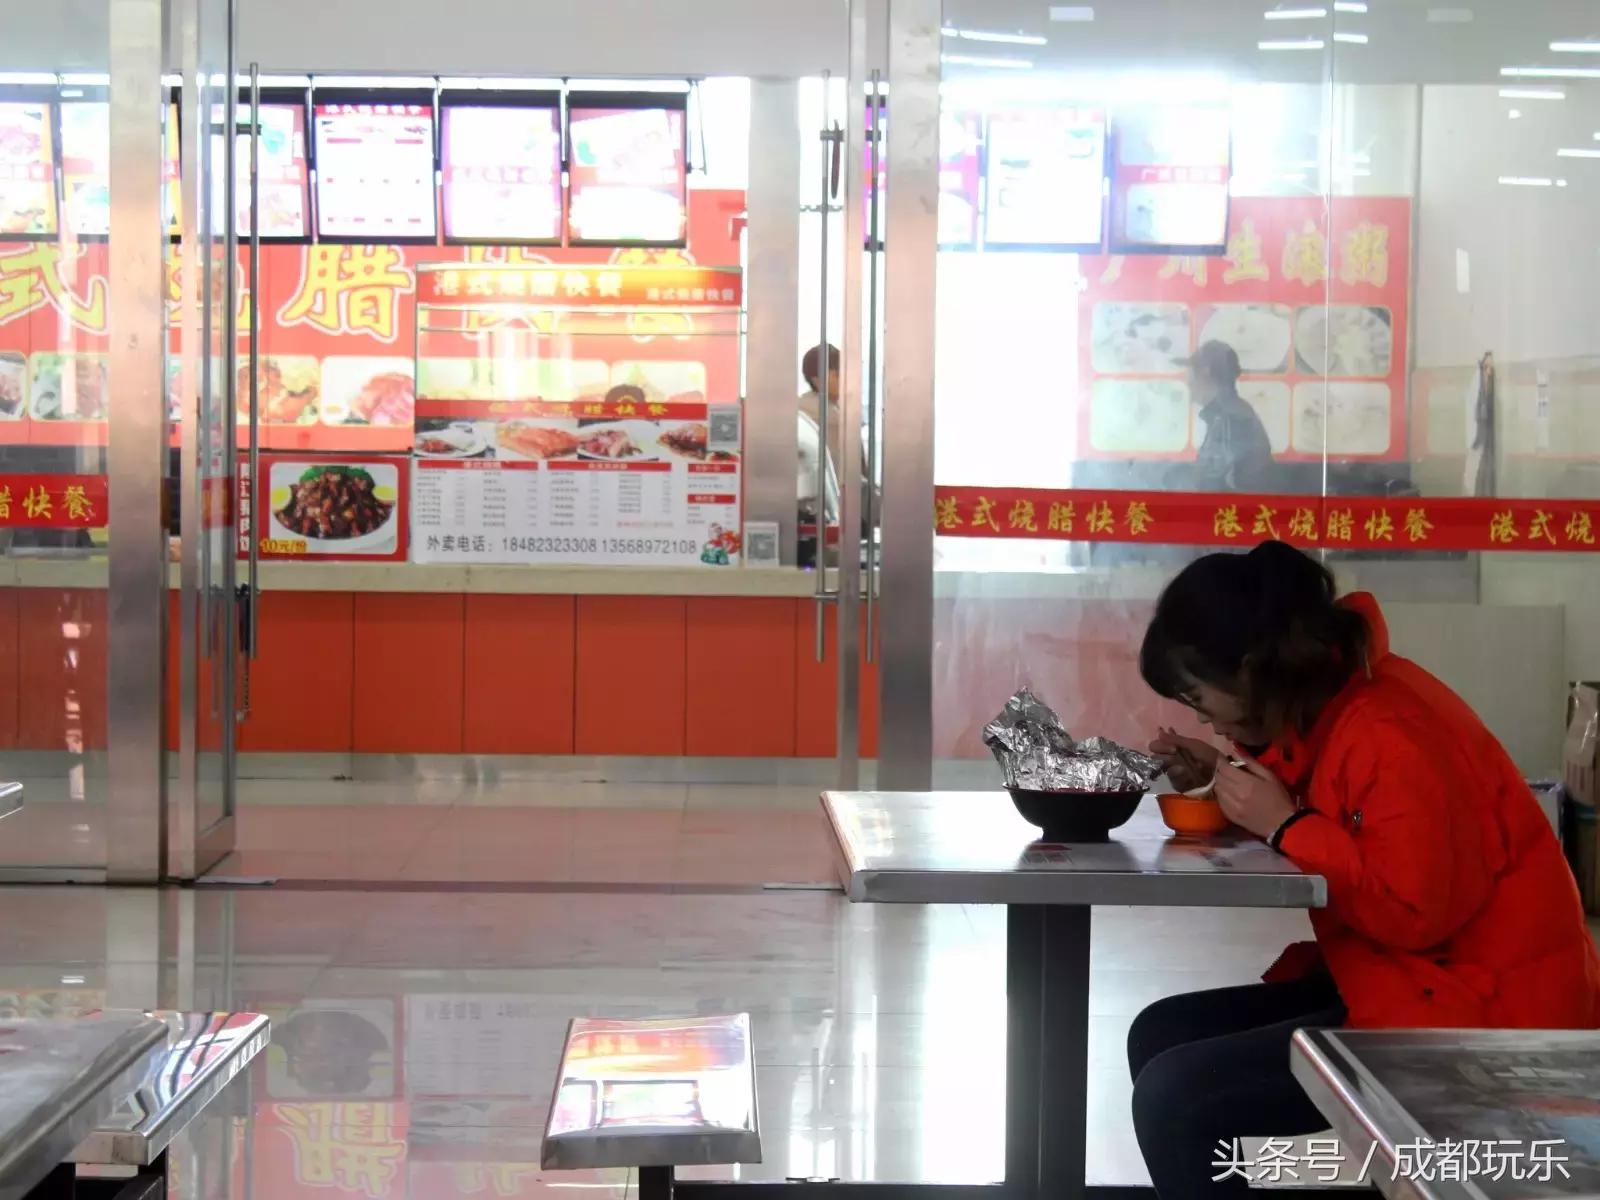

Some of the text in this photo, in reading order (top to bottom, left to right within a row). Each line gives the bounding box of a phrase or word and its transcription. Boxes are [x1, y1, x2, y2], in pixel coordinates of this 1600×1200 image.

[934, 495, 1596, 546] 港式烧腊快餐 港式烧腊快餐 港式烧
[501, 537, 598, 554] 18482323308
[601, 538, 697, 555] 13568972108
